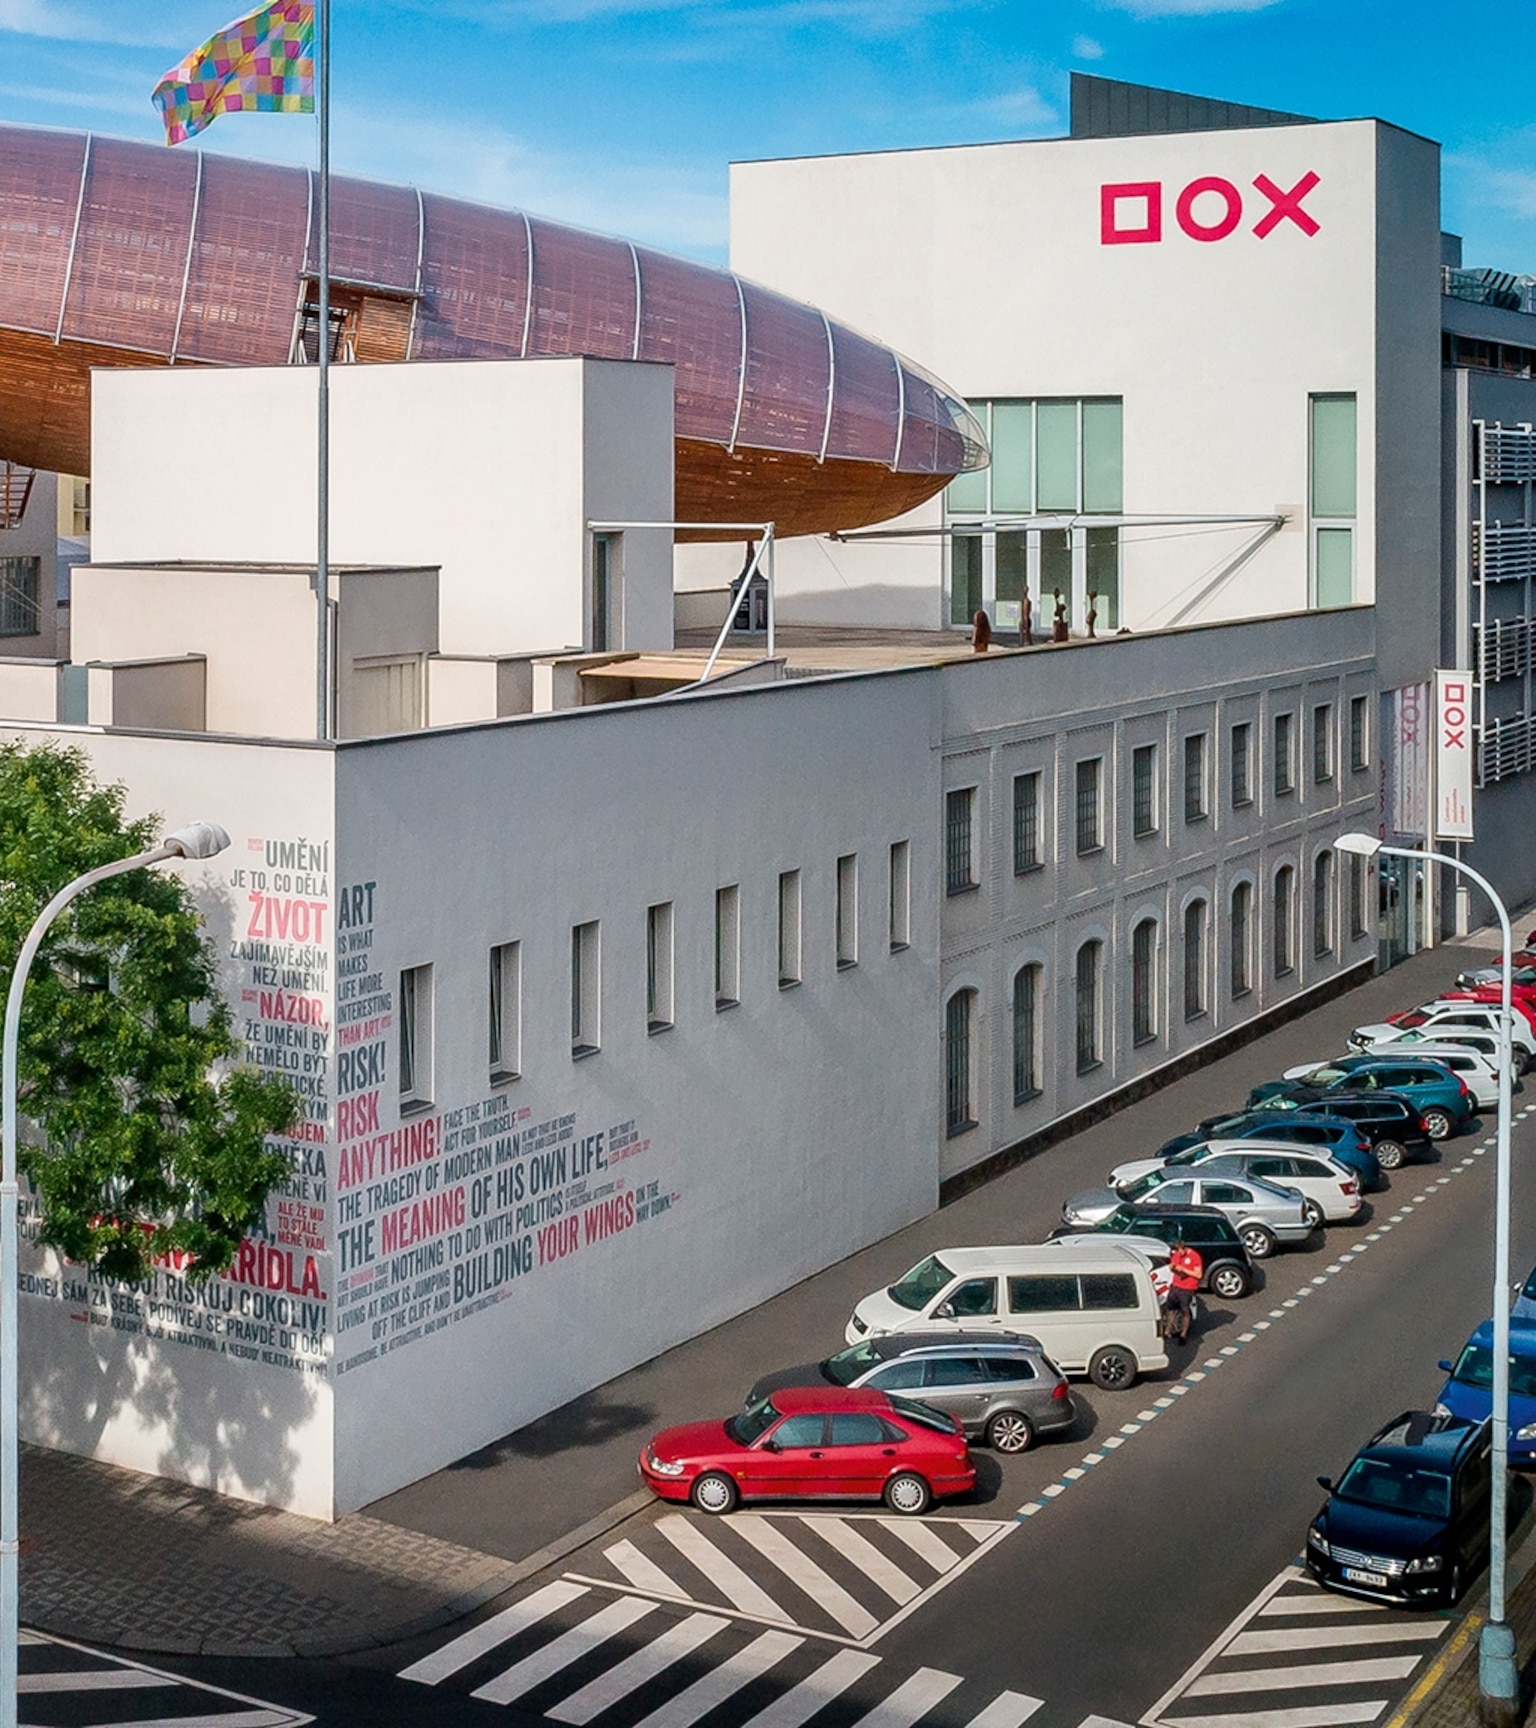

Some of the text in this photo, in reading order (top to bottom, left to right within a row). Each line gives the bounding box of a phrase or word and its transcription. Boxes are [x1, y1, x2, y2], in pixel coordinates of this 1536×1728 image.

[266, 837, 329, 873] UMĚNÍ
[230, 869, 328, 897] JE TO, CO DĚLÁ
[247, 890, 328, 944] ŽIVOT
[338, 881, 377, 930] ART
[230, 939, 328, 970] ZAJÍMAVĚJŠÍM
[338, 928, 374, 955] IS WHAT
[253, 962, 328, 993] NEŽ UMĚNÍ.
[338, 953, 368, 978] MAKES
[338, 972, 383, 1001] LIFE MORE
[260, 987, 329, 1031] NÁZOR,
[337, 992, 392, 1025] INTERESTING
[245, 1019, 328, 1051] ŽE UMĚNÍ BY
[338, 1023, 361, 1047] THAN
[246, 1045, 329, 1074] NEMĚLO BÝT
[337, 1040, 386, 1095] RISK!
[337, 1090, 379, 1143] RISK
[444, 1108, 464, 1131] FACE
[465, 1102, 480, 1124] THE
[337, 1115, 441, 1191] ANYTHING!
[444, 1131, 459, 1153] ACT
[461, 1125, 477, 1147] FOR
[314, 1180, 326, 1203] VÍ
[338, 1133, 520, 1225] THE TRAGEDY OF MODERN MAN
[278, 1201, 293, 1215] ALE
[310, 1207, 324, 1220] MU
[338, 1219, 375, 1272] THE
[382, 1185, 465, 1256] MEANING
[471, 1174, 493, 1219] OF
[497, 1162, 525, 1209] HIS
[530, 1146, 566, 1196] OWN
[572, 1132, 608, 1179] LIFE,
[278, 1215, 289, 1229] TO
[391, 1239, 444, 1285] NOTHING
[448, 1232, 462, 1261] TO
[466, 1224, 480, 1254] DO
[484, 1210, 512, 1246] WITH
[516, 1190, 563, 1233] POLITICS
[454, 1191, 634, 1304] BUILDING YOUR WINGS
[18, 1272, 58, 1298] EDNEJ
[63, 1280, 88, 1304] SÁM
[92, 1289, 107, 1307] ZA
[150, 1301, 202, 1330] PODÍVEJ
[207, 1313, 222, 1334] SE
[226, 1318, 275, 1347] PRAVDĚ
[280, 1331, 296, 1350] DO
[166, 1273, 232, 1313] RISKUJ
[239, 1289, 327, 1333] COKOLIV!
[337, 1269, 450, 1334] LIVING AT RISK IS JUMPING
[371, 1290, 450, 1341] OFF THE CLIFF AND
[221, 1341, 227, 1355] A
